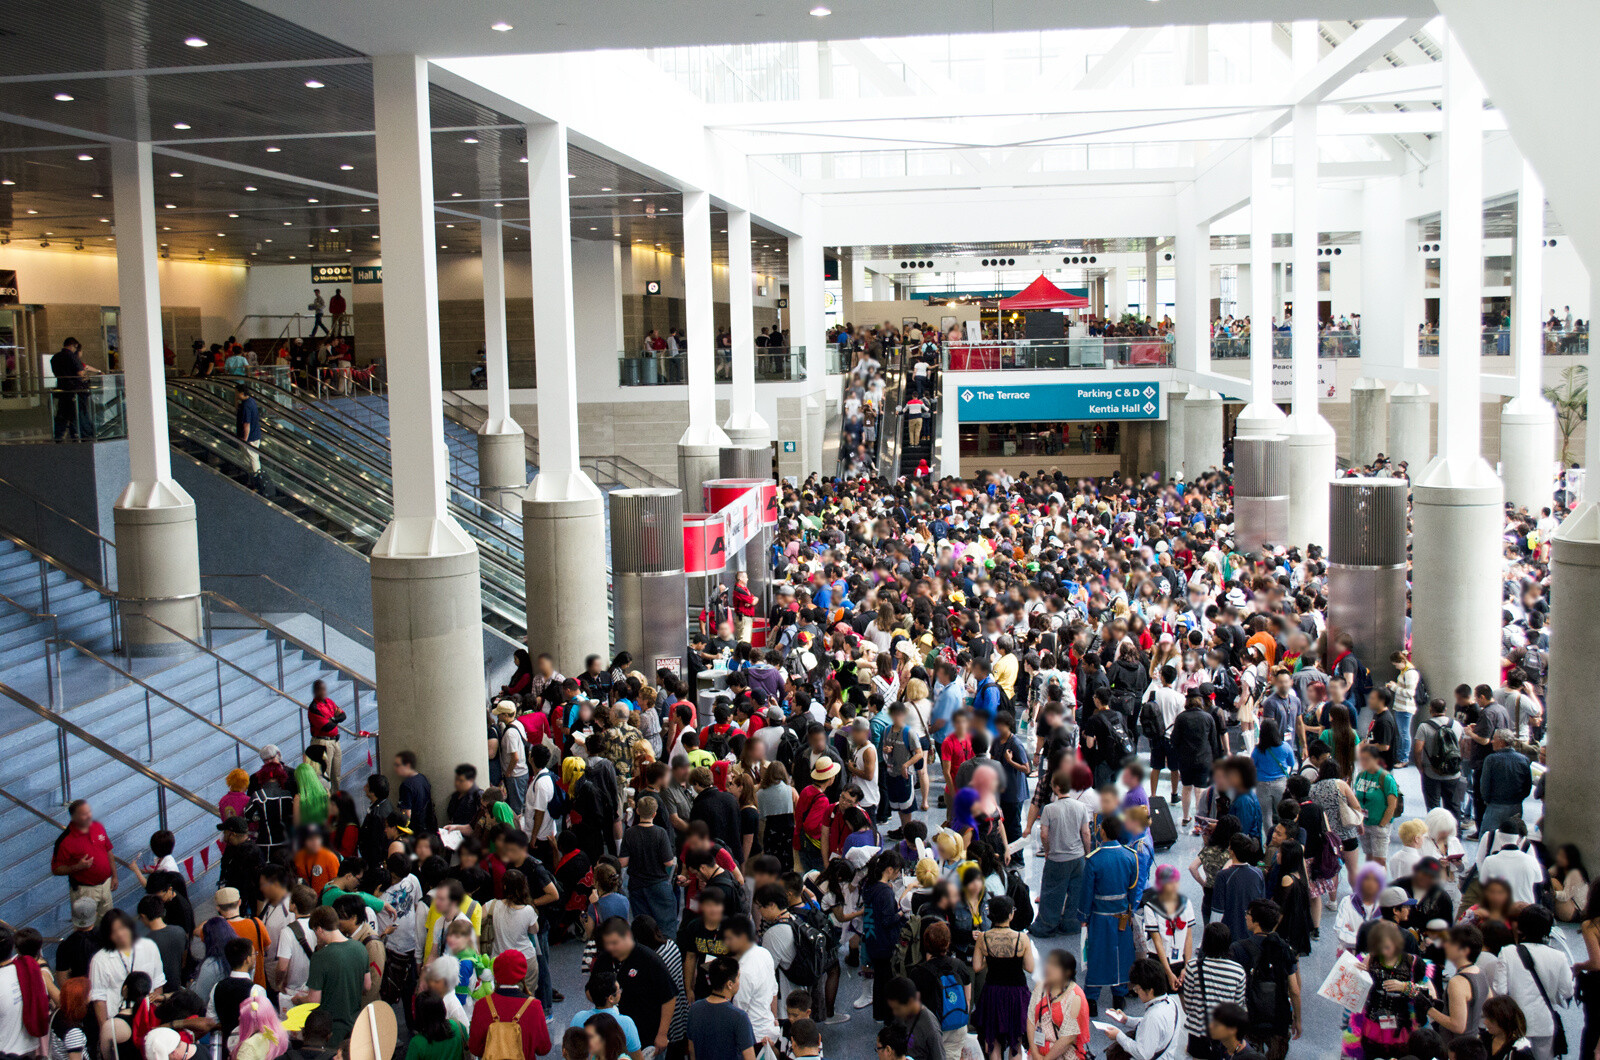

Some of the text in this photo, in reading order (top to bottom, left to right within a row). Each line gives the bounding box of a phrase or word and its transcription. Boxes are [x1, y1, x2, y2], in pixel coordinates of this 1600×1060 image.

[358, 270, 374, 280] Hall
[976, 390, 1031, 400] The Terrace
[1077, 388, 1140, 400] Parking C & D
[1089, 403, 1140, 413] Kentia Hall
[656, 658, 680, 667] DANGER
